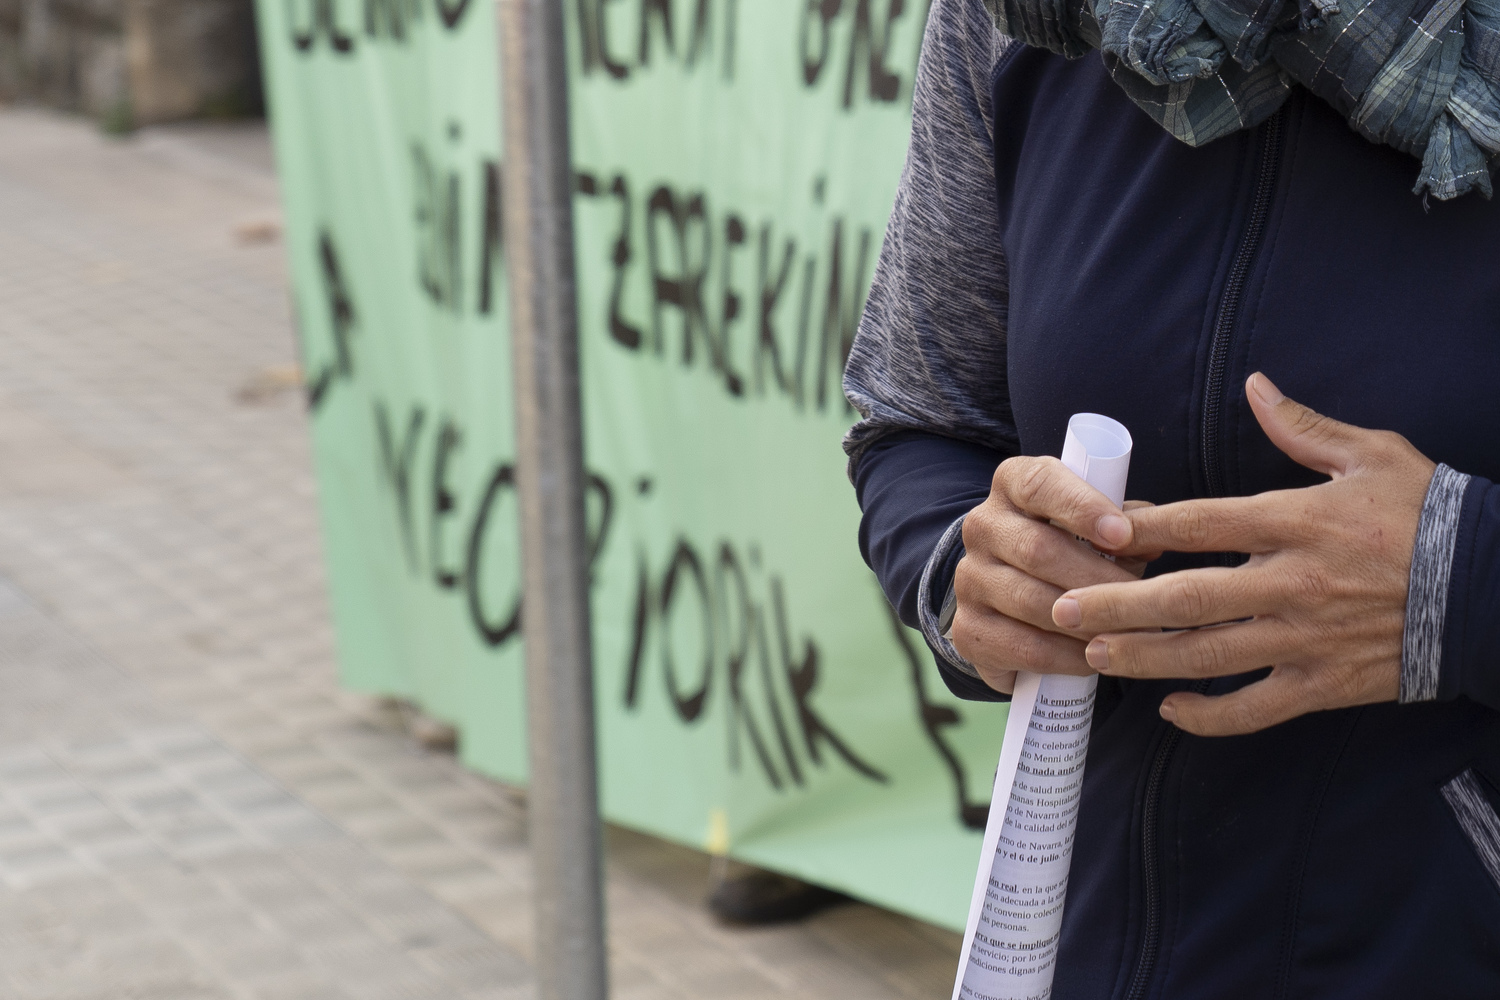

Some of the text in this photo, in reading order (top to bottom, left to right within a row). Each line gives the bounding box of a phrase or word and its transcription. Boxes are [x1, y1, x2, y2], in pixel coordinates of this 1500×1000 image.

[1040, 694, 1049, 704] la
[1051, 696, 1087, 707] empresa
[1034, 706, 1046, 717] las
[1029, 720, 1043, 731] ace
[1045, 723, 1069, 732] oídos
[1023, 737, 1040, 748] nión
[1034, 752, 1062, 763] Menni
[1064, 754, 1074, 762] de
[1017, 761, 1031, 772] cho
[1032, 767, 1055, 776] nada
[1057, 766, 1075, 776] ante
[1018, 781, 1028, 791] de
[1029, 785, 1052, 794] salud
[1010, 792, 1034, 807] manas
[1014, 806, 1024, 816] de
[1025, 809, 1060, 820] Navarra
[1014, 820, 1022, 829] la
[1023, 823, 1055, 833] calidad
[1056, 819, 1068, 831] del
[999, 835, 1015, 847] erno
[1016, 840, 1027, 849] de
[1003, 850, 1008, 859] y
[1009, 852, 1017, 860] el
[1018, 853, 1025, 862] 6
[1027, 854, 1038, 863] de
[1035, 885, 1043, 894] la
[1044, 884, 1058, 894] que
[1000, 896, 1039, 907] adecuada
[1047, 896, 1054, 905] la
[986, 902, 993, 912] el
[993, 906, 1032, 919] convenio
[991, 919, 1029, 932] personas.
[990, 938, 1006, 950] que
[1007, 942, 1017, 950] se
[1011, 955, 1026, 964] por
[1029, 953, 1037, 962] lo
[1008, 966, 1036, 977] dignas
